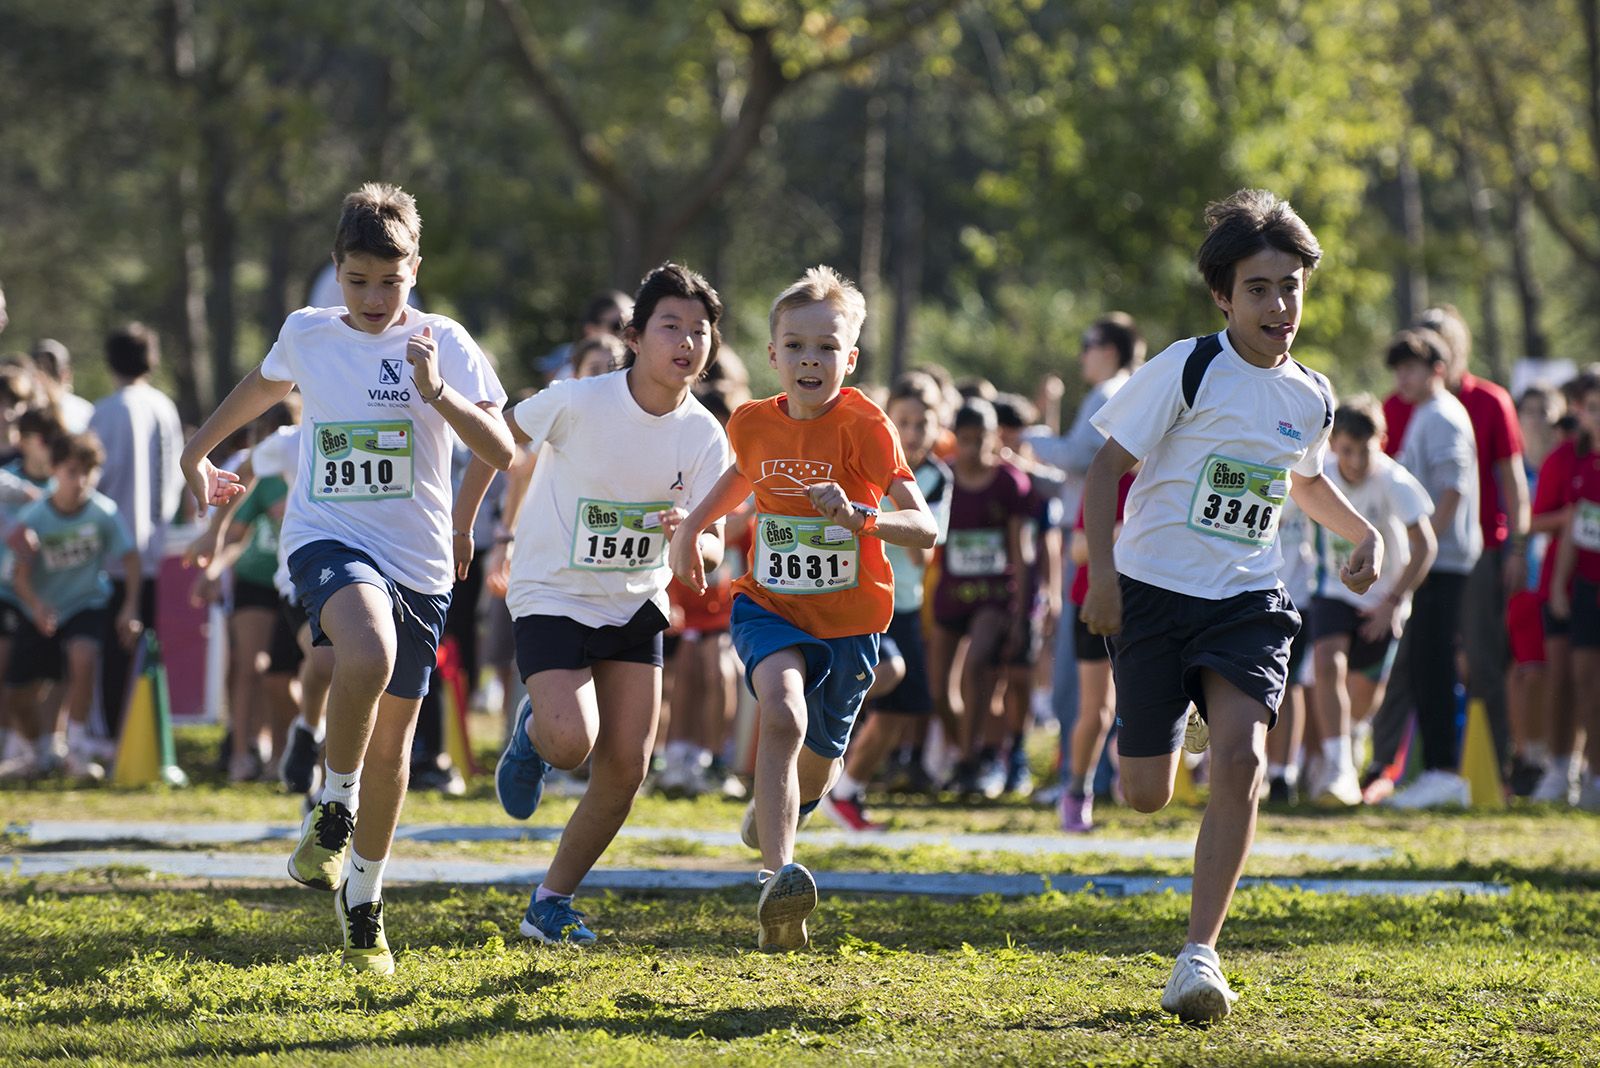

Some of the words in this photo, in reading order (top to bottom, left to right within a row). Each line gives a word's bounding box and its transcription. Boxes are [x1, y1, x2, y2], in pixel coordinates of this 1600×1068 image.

[368, 388, 410, 401] VIARÓ
[322, 433, 348, 452] CROS
[325, 459, 393, 486] 3910
[1213, 472, 1246, 485] CROS
[588, 512, 618, 525] CROS
[1203, 494, 1273, 531] 3346
[766, 527, 794, 542] CROS
[588, 535, 650, 558] 1540
[769, 553, 839, 579] 3631
